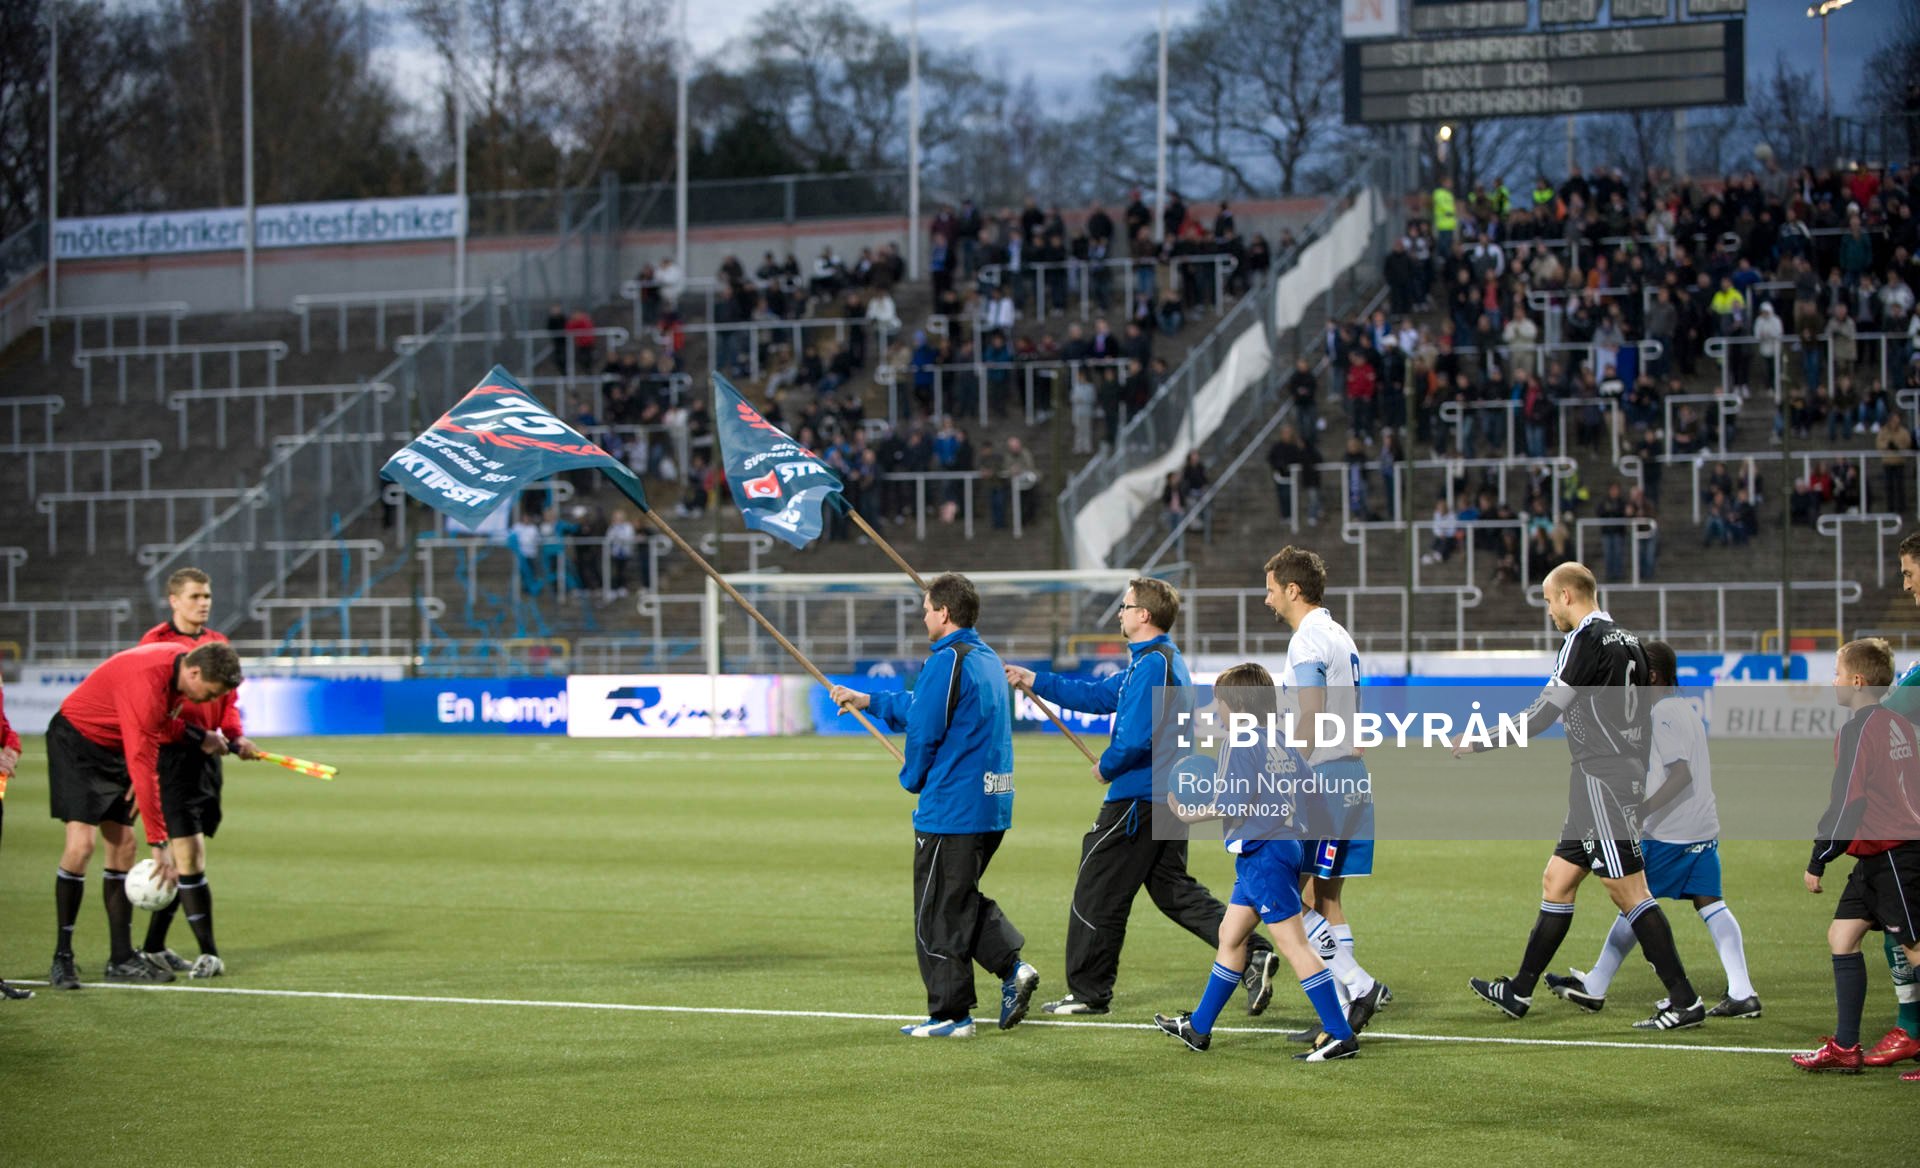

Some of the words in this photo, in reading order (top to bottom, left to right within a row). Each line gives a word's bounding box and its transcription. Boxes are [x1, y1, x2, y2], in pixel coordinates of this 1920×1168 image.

[1611, 29, 1643, 52] XL
[1422, 66, 1483, 89] MAXI
[1504, 63, 1549, 83] ICA
[1408, 86, 1583, 118] STORMARKNAD
[56, 217, 245, 253] mötesfabriker
[256, 203, 459, 240] mötesfabriker
[437, 692, 474, 722] En
[1727, 707, 1851, 733] BILLERU
